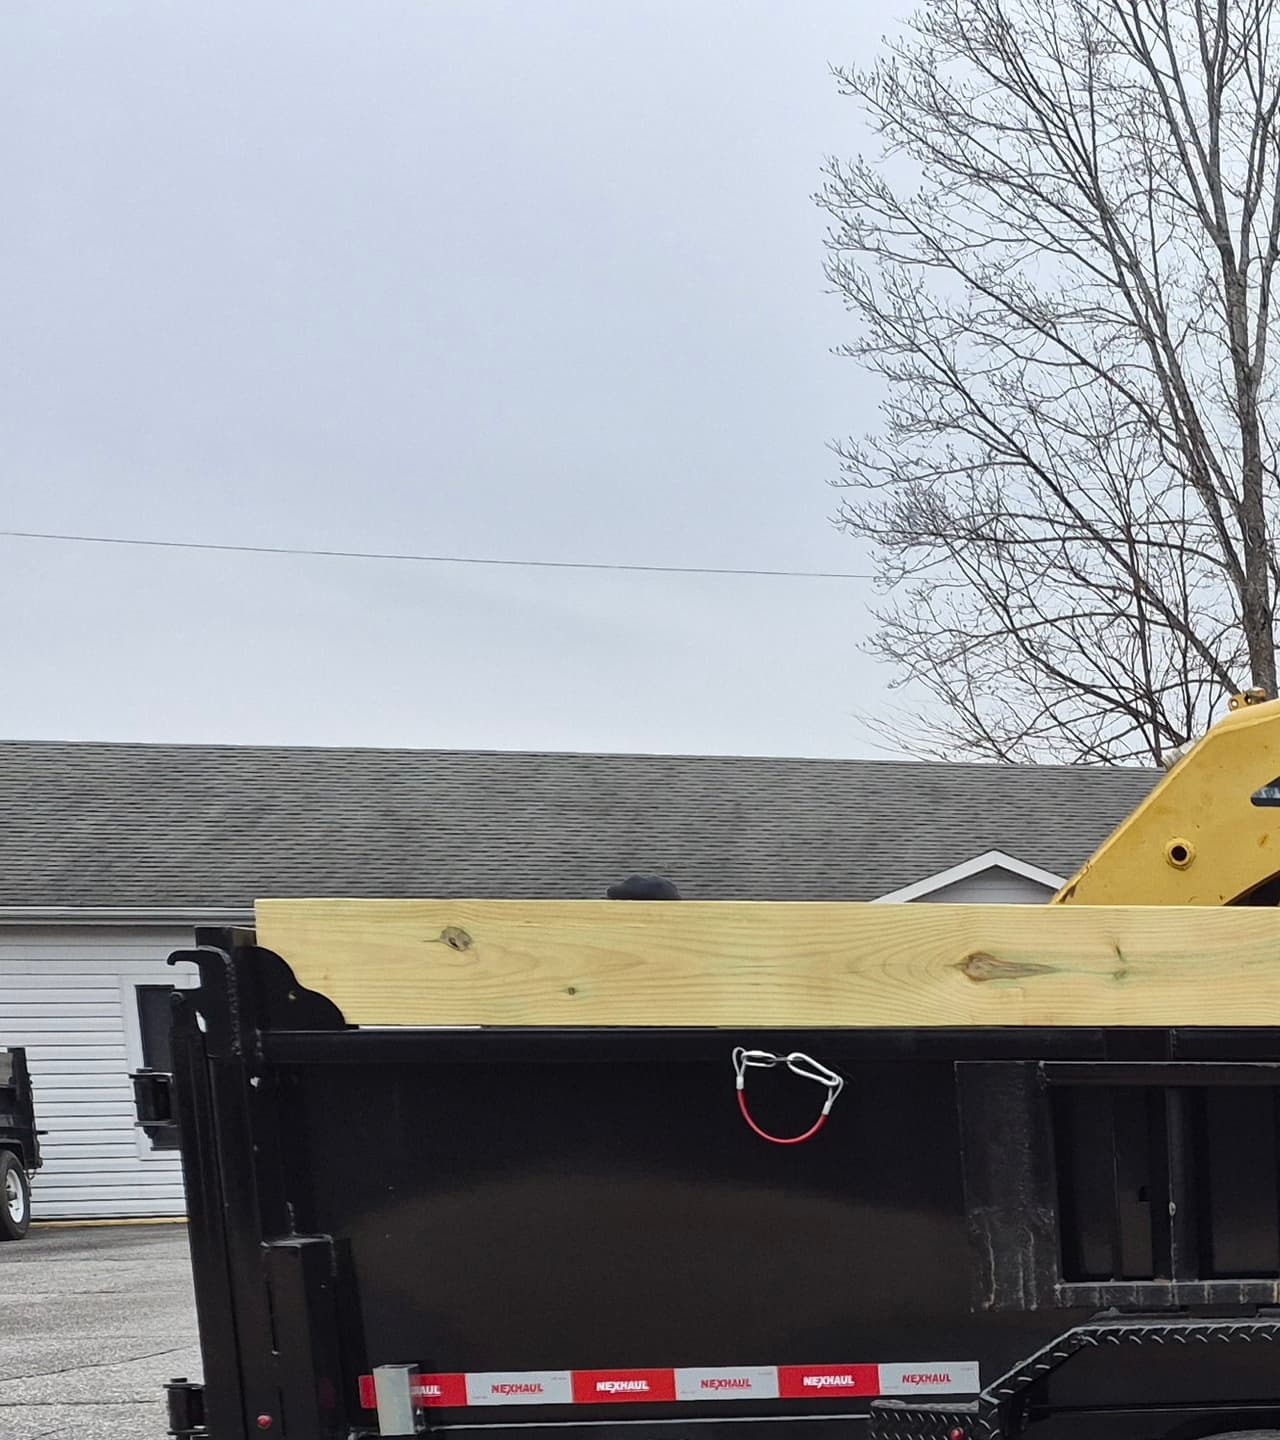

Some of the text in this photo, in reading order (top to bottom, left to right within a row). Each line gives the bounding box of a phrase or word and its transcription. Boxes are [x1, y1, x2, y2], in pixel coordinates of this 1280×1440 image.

[701, 1378, 752, 1391] NEXHAUL
[803, 1375, 854, 1389] NEXHAUL
[902, 1373, 952, 1386] NEXHAUL
[491, 1383, 544, 1396] NEXHAUL
[596, 1380, 649, 1394] NEXHAUL
